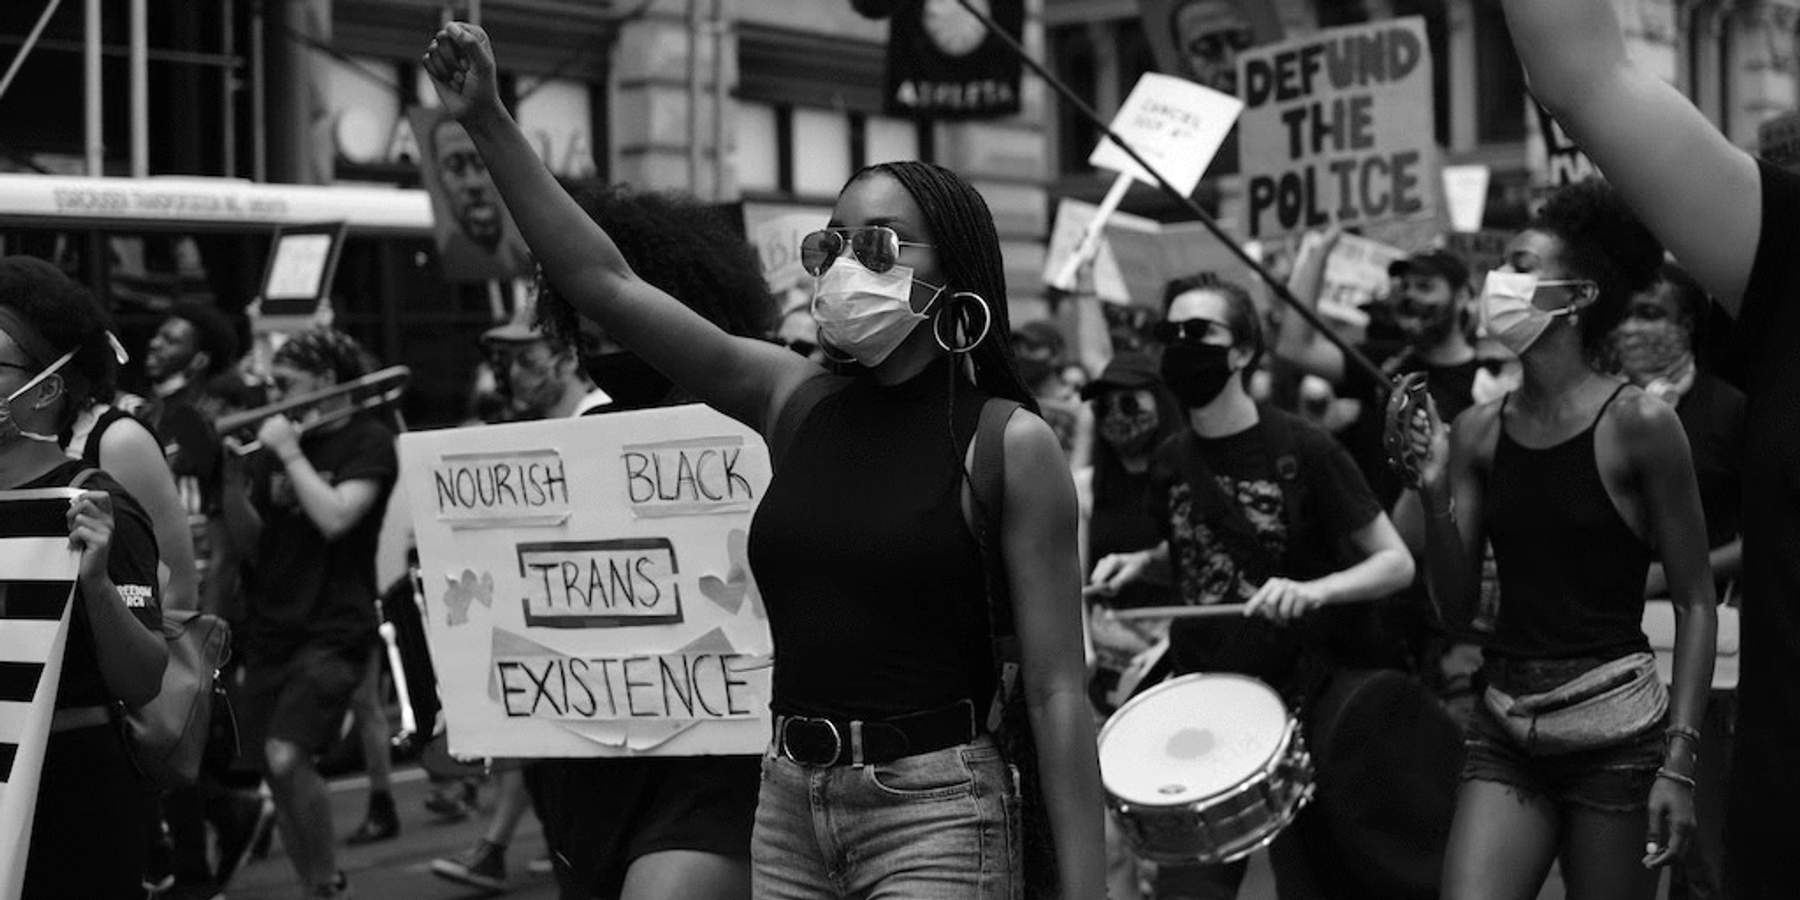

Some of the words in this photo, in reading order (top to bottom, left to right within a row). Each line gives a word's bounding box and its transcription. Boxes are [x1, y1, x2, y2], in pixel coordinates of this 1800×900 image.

[1247, 28, 1422, 108] DEFUND
[1282, 95, 1375, 160] THE
[1249, 151, 1423, 238] POLICE
[434, 460, 569, 512] NOURISH
[621, 449, 753, 503] BLACK
[116, 584, 152, 597] REEDOM
[528, 557, 660, 607] TRANS
[498, 654, 751, 717] EXISTENCE
